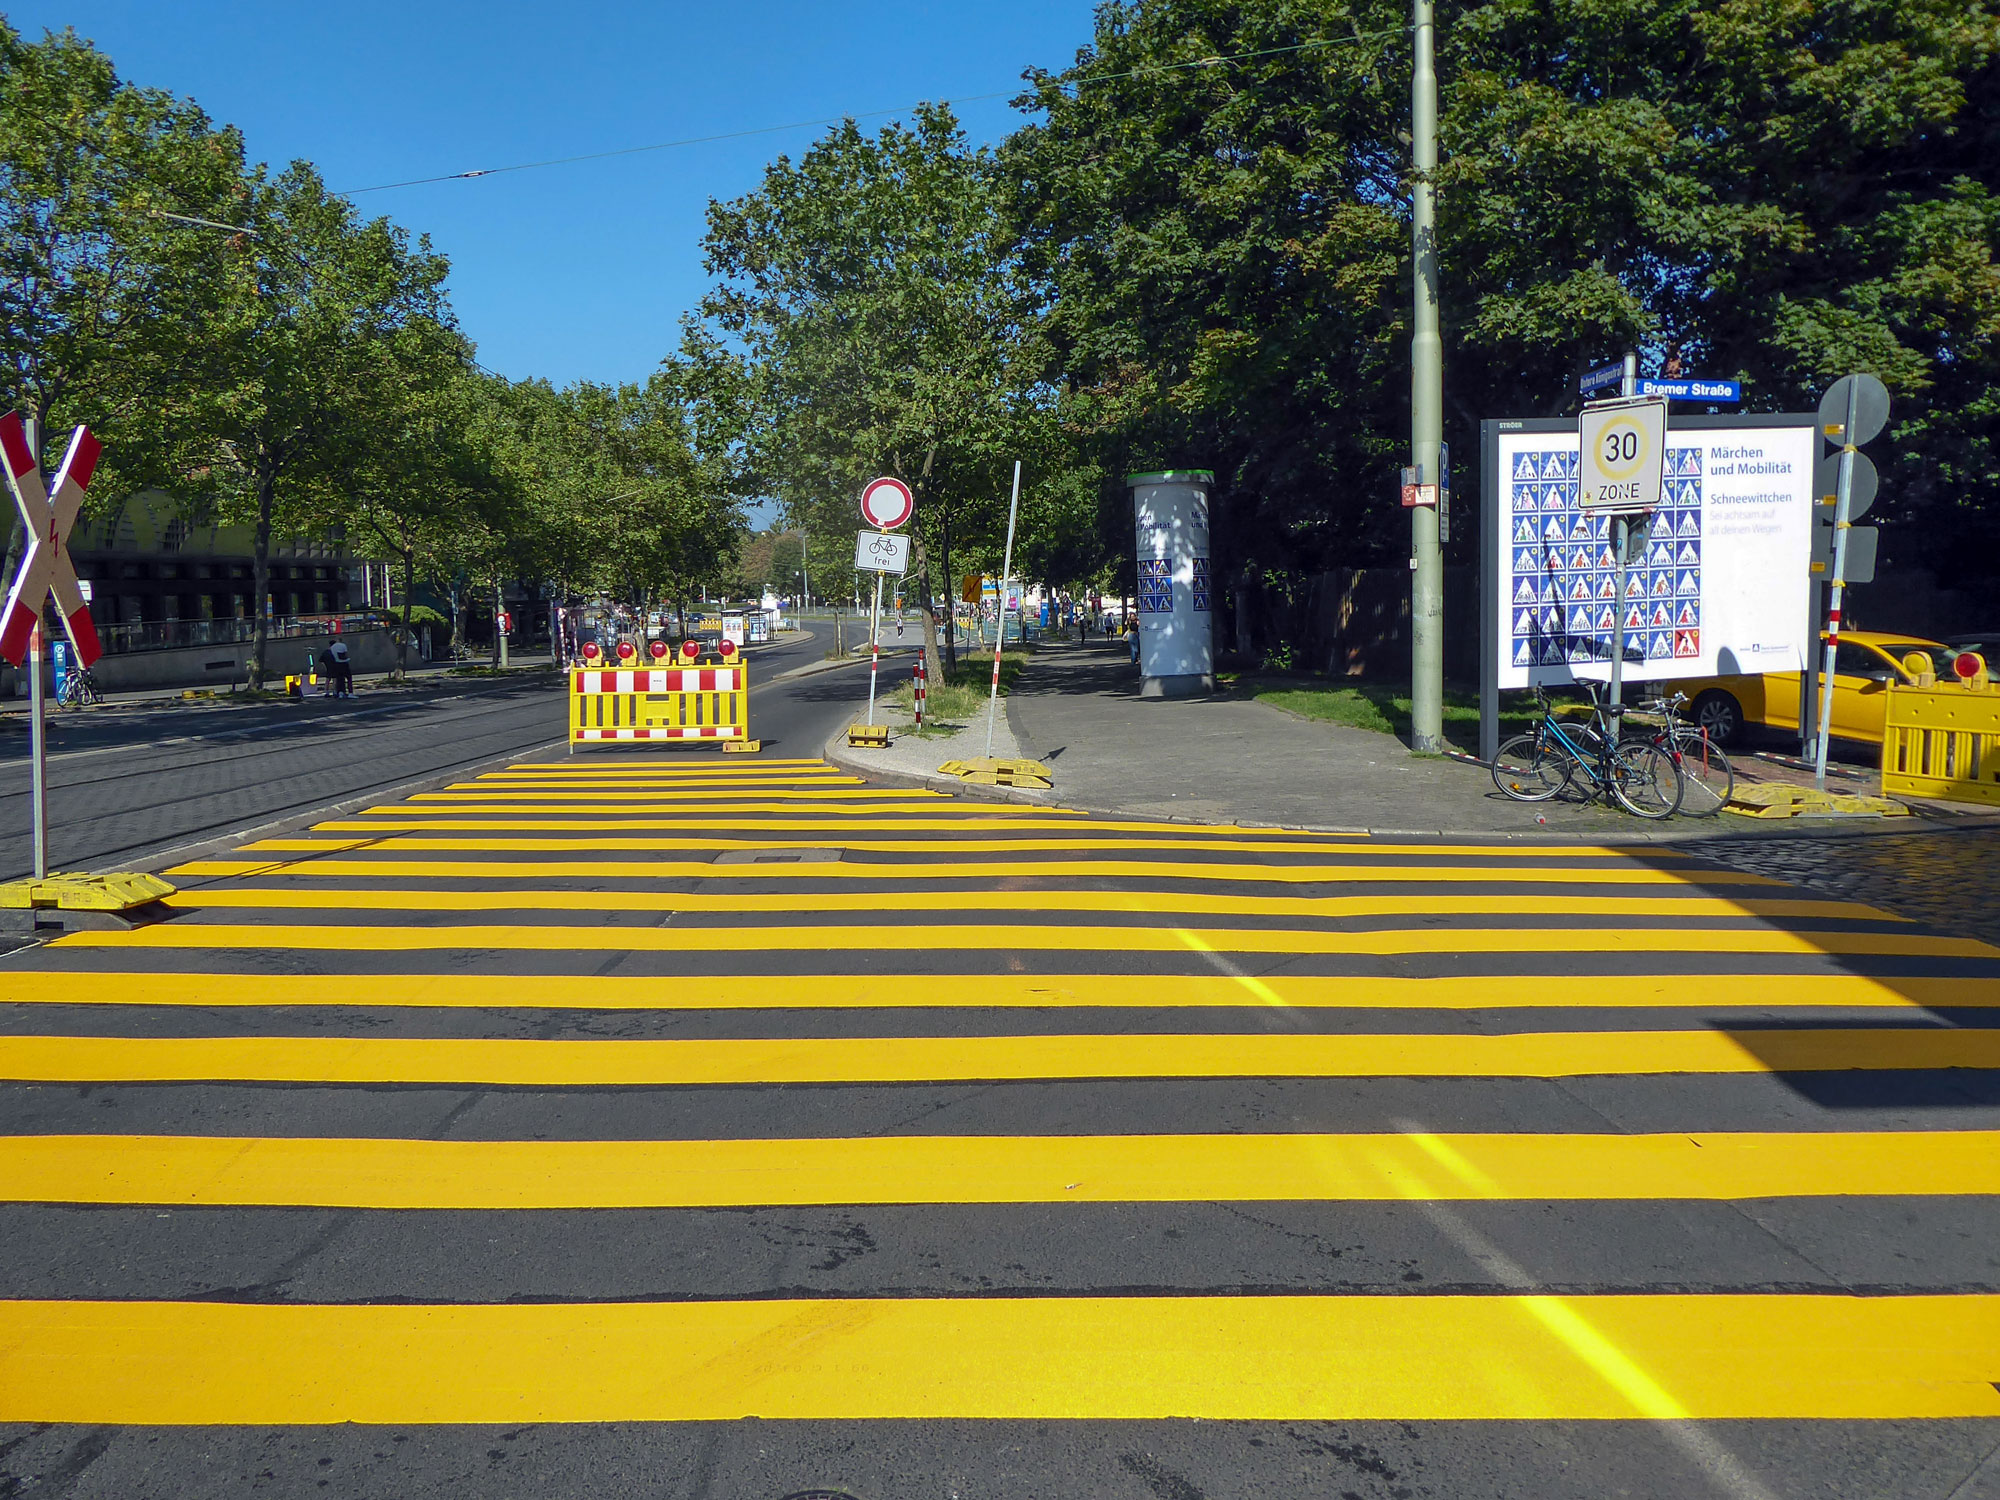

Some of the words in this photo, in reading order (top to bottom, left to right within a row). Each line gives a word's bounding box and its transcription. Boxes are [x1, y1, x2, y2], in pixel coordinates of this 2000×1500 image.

[1643, 381, 1688, 395] Bremer
[1691, 384, 1733, 397] Straße
[1605, 431, 1638, 463] 30
[1710, 445, 1764, 459] Märchen
[1710, 462, 1735, 476] und
[1737, 461, 1792, 475] Mobilität
[1598, 482, 1641, 501] ZONE
[1710, 491, 1793, 505] Schneewittchen
[874, 555, 890, 566] frei
